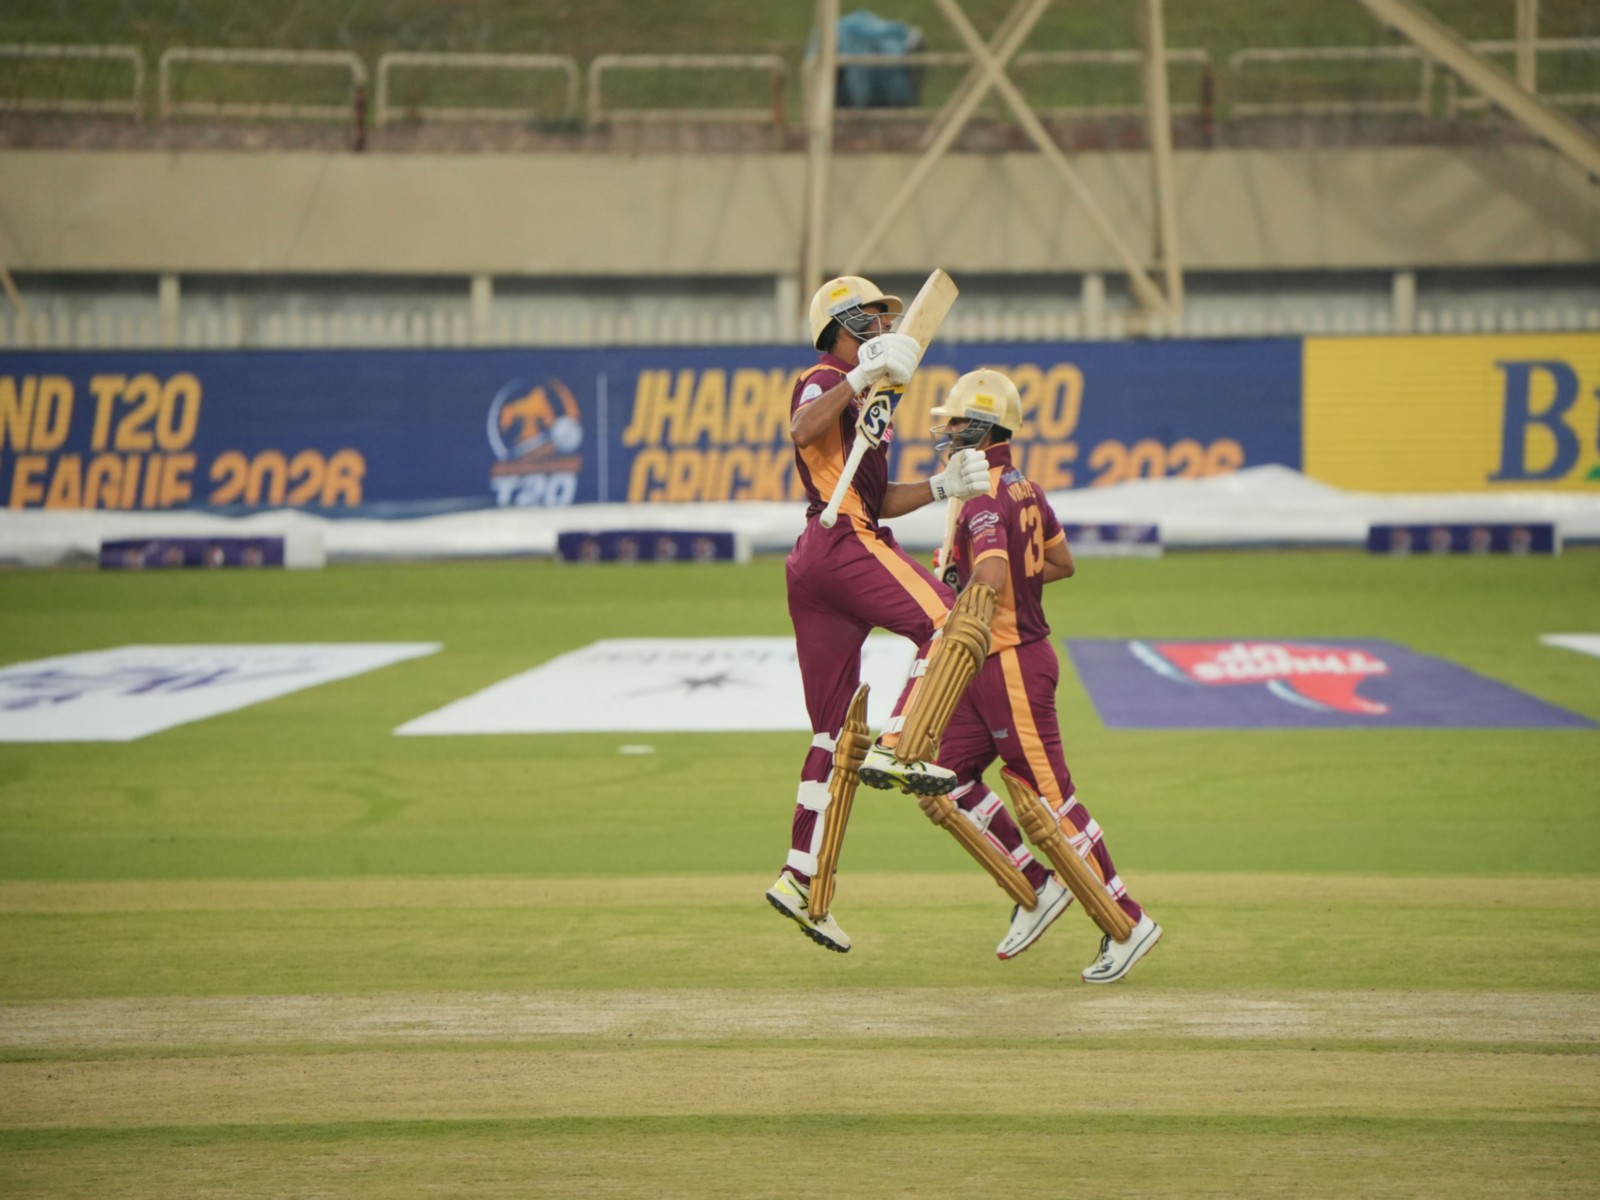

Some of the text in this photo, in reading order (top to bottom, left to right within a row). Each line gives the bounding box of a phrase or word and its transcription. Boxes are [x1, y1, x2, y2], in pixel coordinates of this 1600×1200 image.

[89, 371, 202, 451] T20
[1487, 358, 1600, 483] B
[209, 448, 367, 508] 2026
[490, 473, 578, 508] T20
